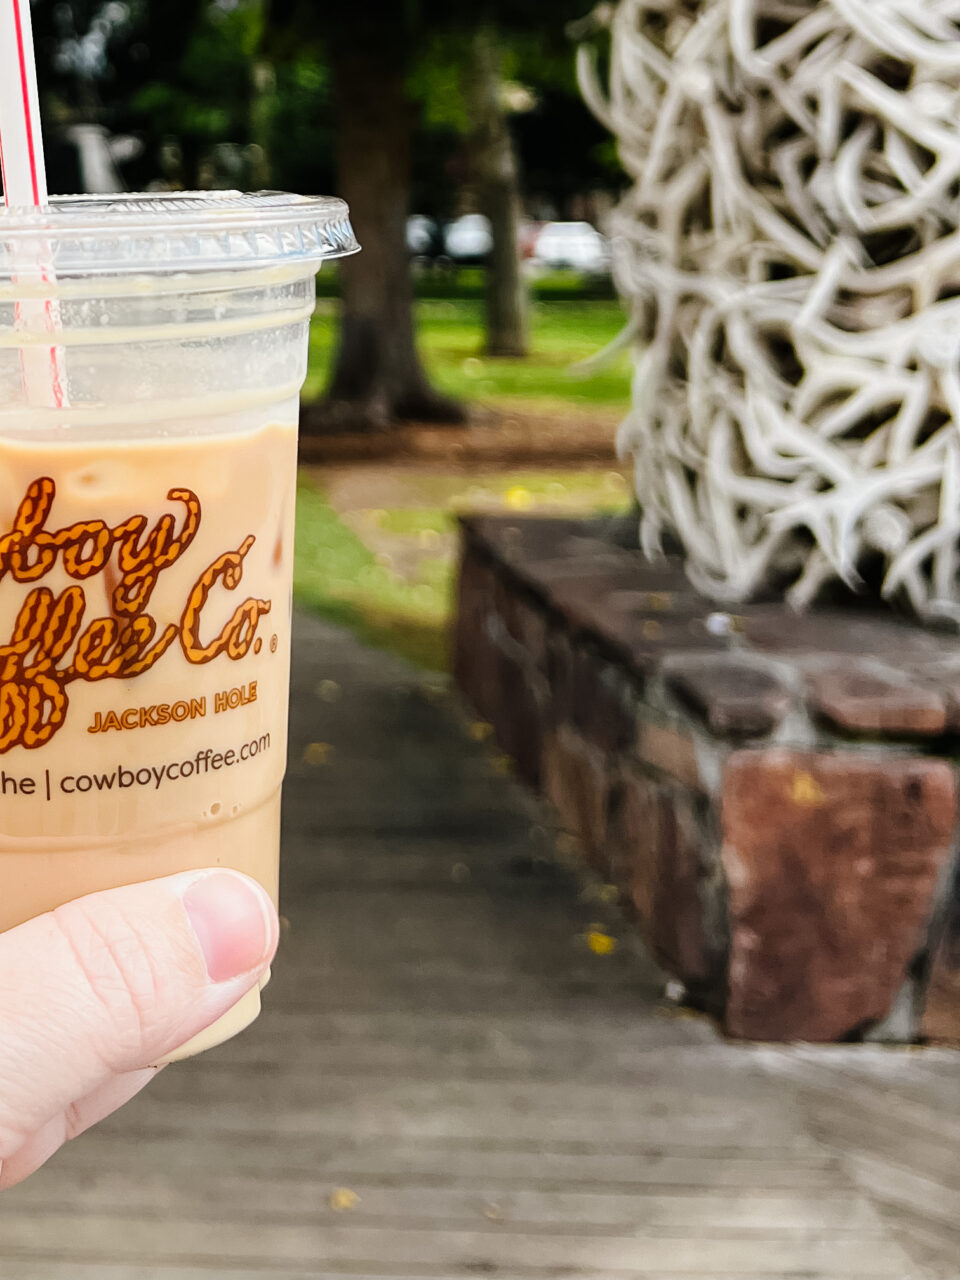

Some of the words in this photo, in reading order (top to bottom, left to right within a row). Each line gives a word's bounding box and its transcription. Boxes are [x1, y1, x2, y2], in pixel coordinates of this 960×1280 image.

[180, 534, 272, 665] Co.
[87, 695, 207, 734] JACKSON
[214, 680, 258, 714] HOLE
[59, 731, 272, 794] cowboycoffee.com
